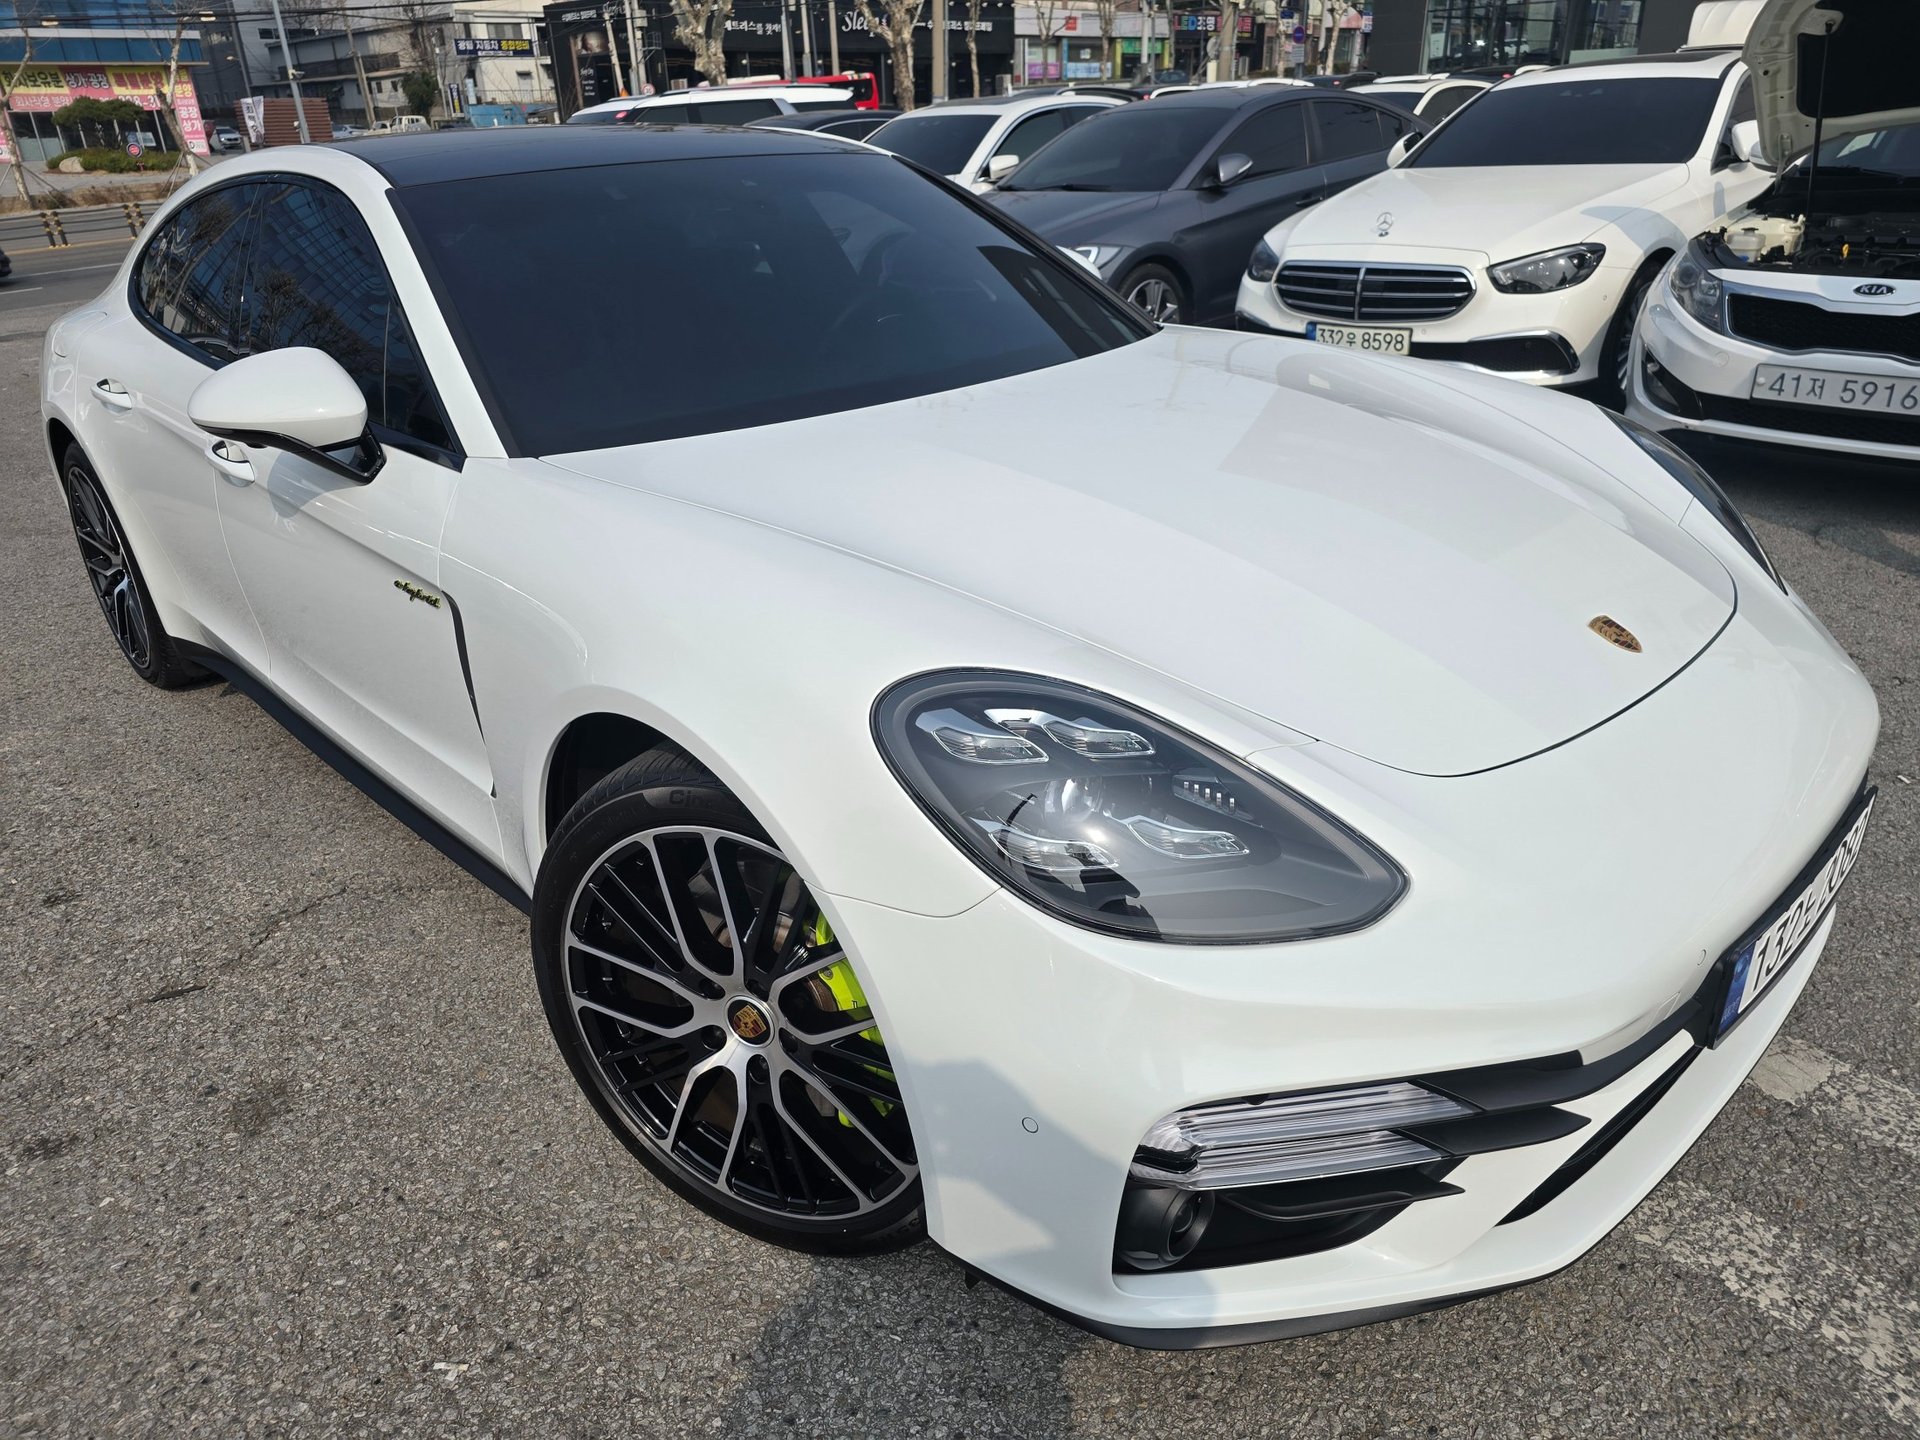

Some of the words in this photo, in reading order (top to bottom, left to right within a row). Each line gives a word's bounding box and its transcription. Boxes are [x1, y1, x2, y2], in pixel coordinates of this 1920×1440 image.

[179, 106, 198, 119] 공장
[182, 119, 202, 132] 상가
[1859, 285, 1888, 294] KIA
[1317, 328, 1357, 348] 332우
[1361, 331, 1405, 352] 8598
[1768, 372, 1827, 400] 41저
[1839, 379, 1919, 411] 5916
[1753, 891, 1817, 993] 132노
[1816, 809, 1869, 915] 2082
